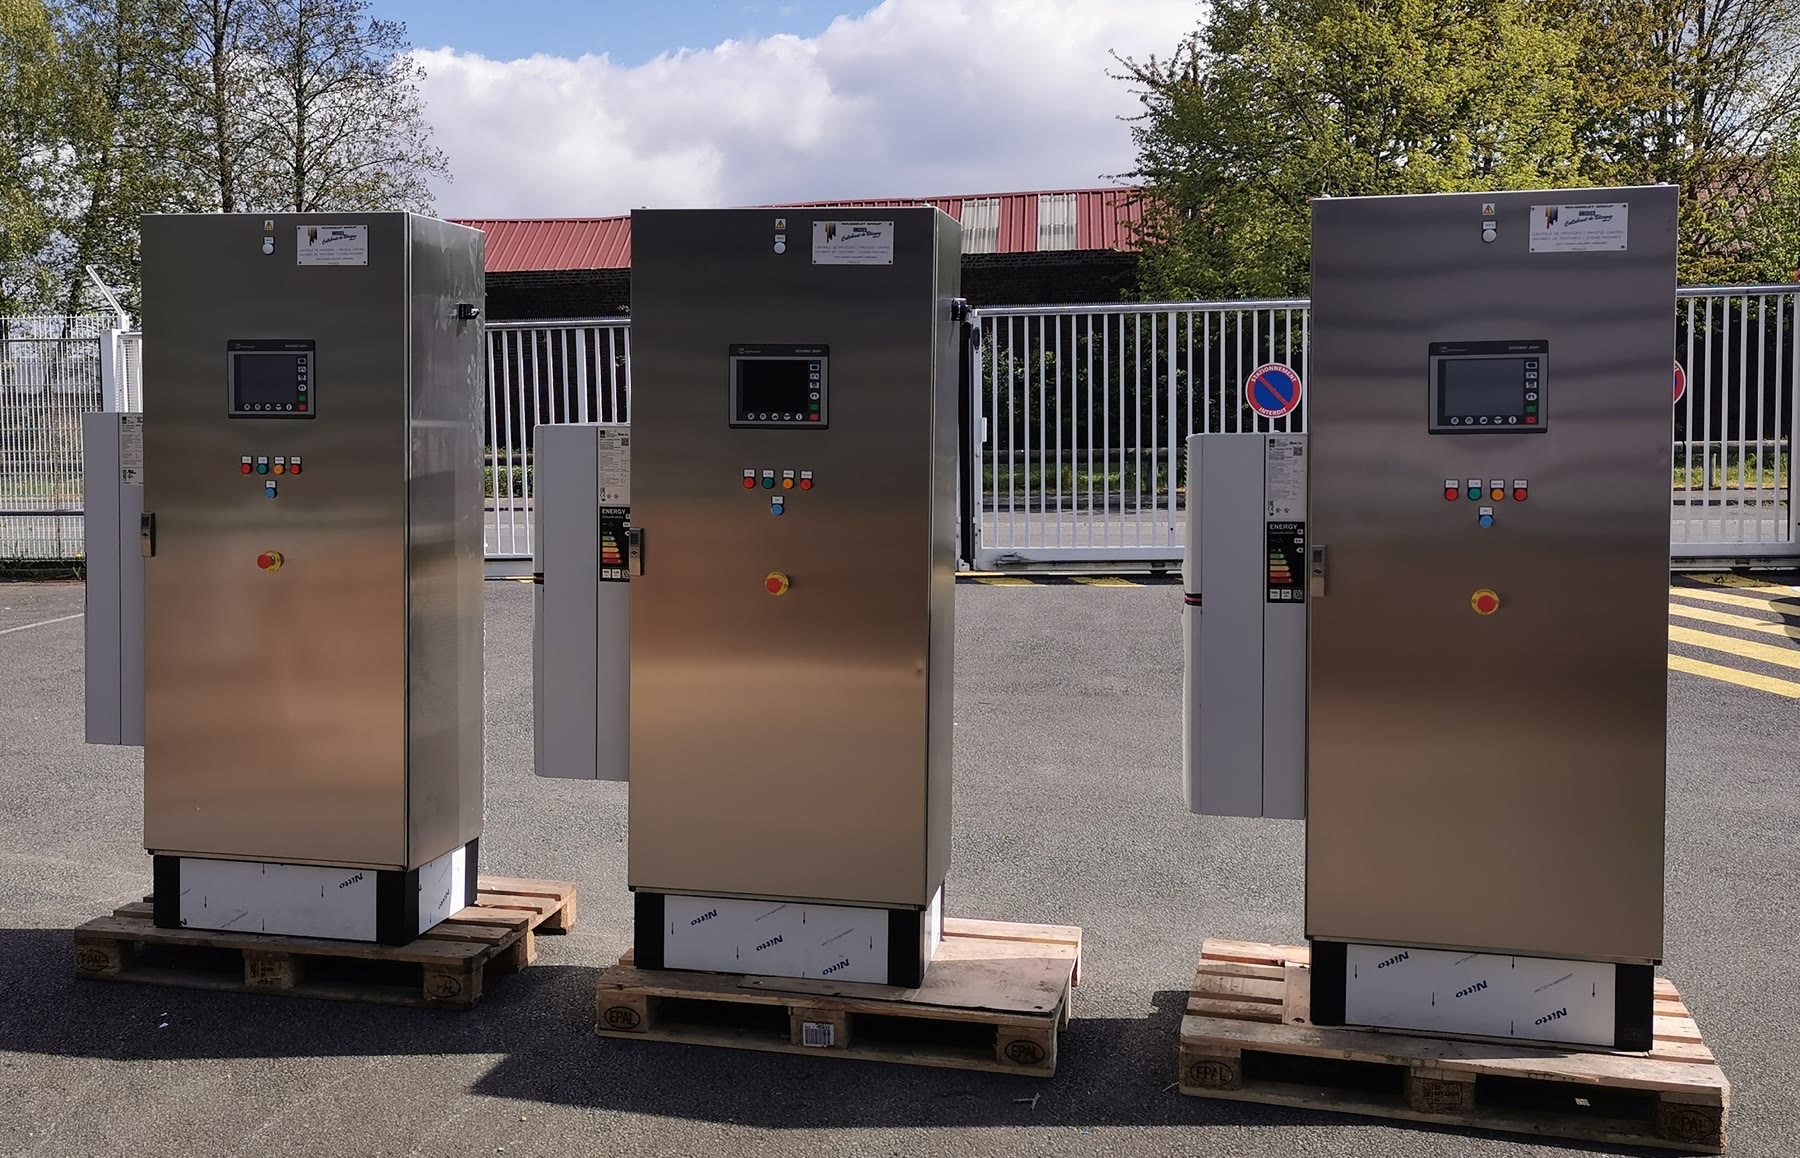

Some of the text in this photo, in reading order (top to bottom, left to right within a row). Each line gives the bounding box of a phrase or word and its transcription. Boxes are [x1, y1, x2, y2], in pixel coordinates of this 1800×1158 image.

[1251, 366, 1297, 382] STATIONNEMENT
[1259, 407, 1287, 415] INTERDIT
[339, 873, 363, 888] Nitto
[691, 909, 717, 925] Nitto
[756, 935, 783, 951] Nitto
[823, 959, 849, 975] Nitto
[1378, 951, 1409, 968] Nitto
[1456, 980, 1487, 997] Nitto
[610, 1010, 636, 1026] EPAL
[1535, 1008, 1567, 1025] Nitto
[1011, 1044, 1040, 1060] EPAL
